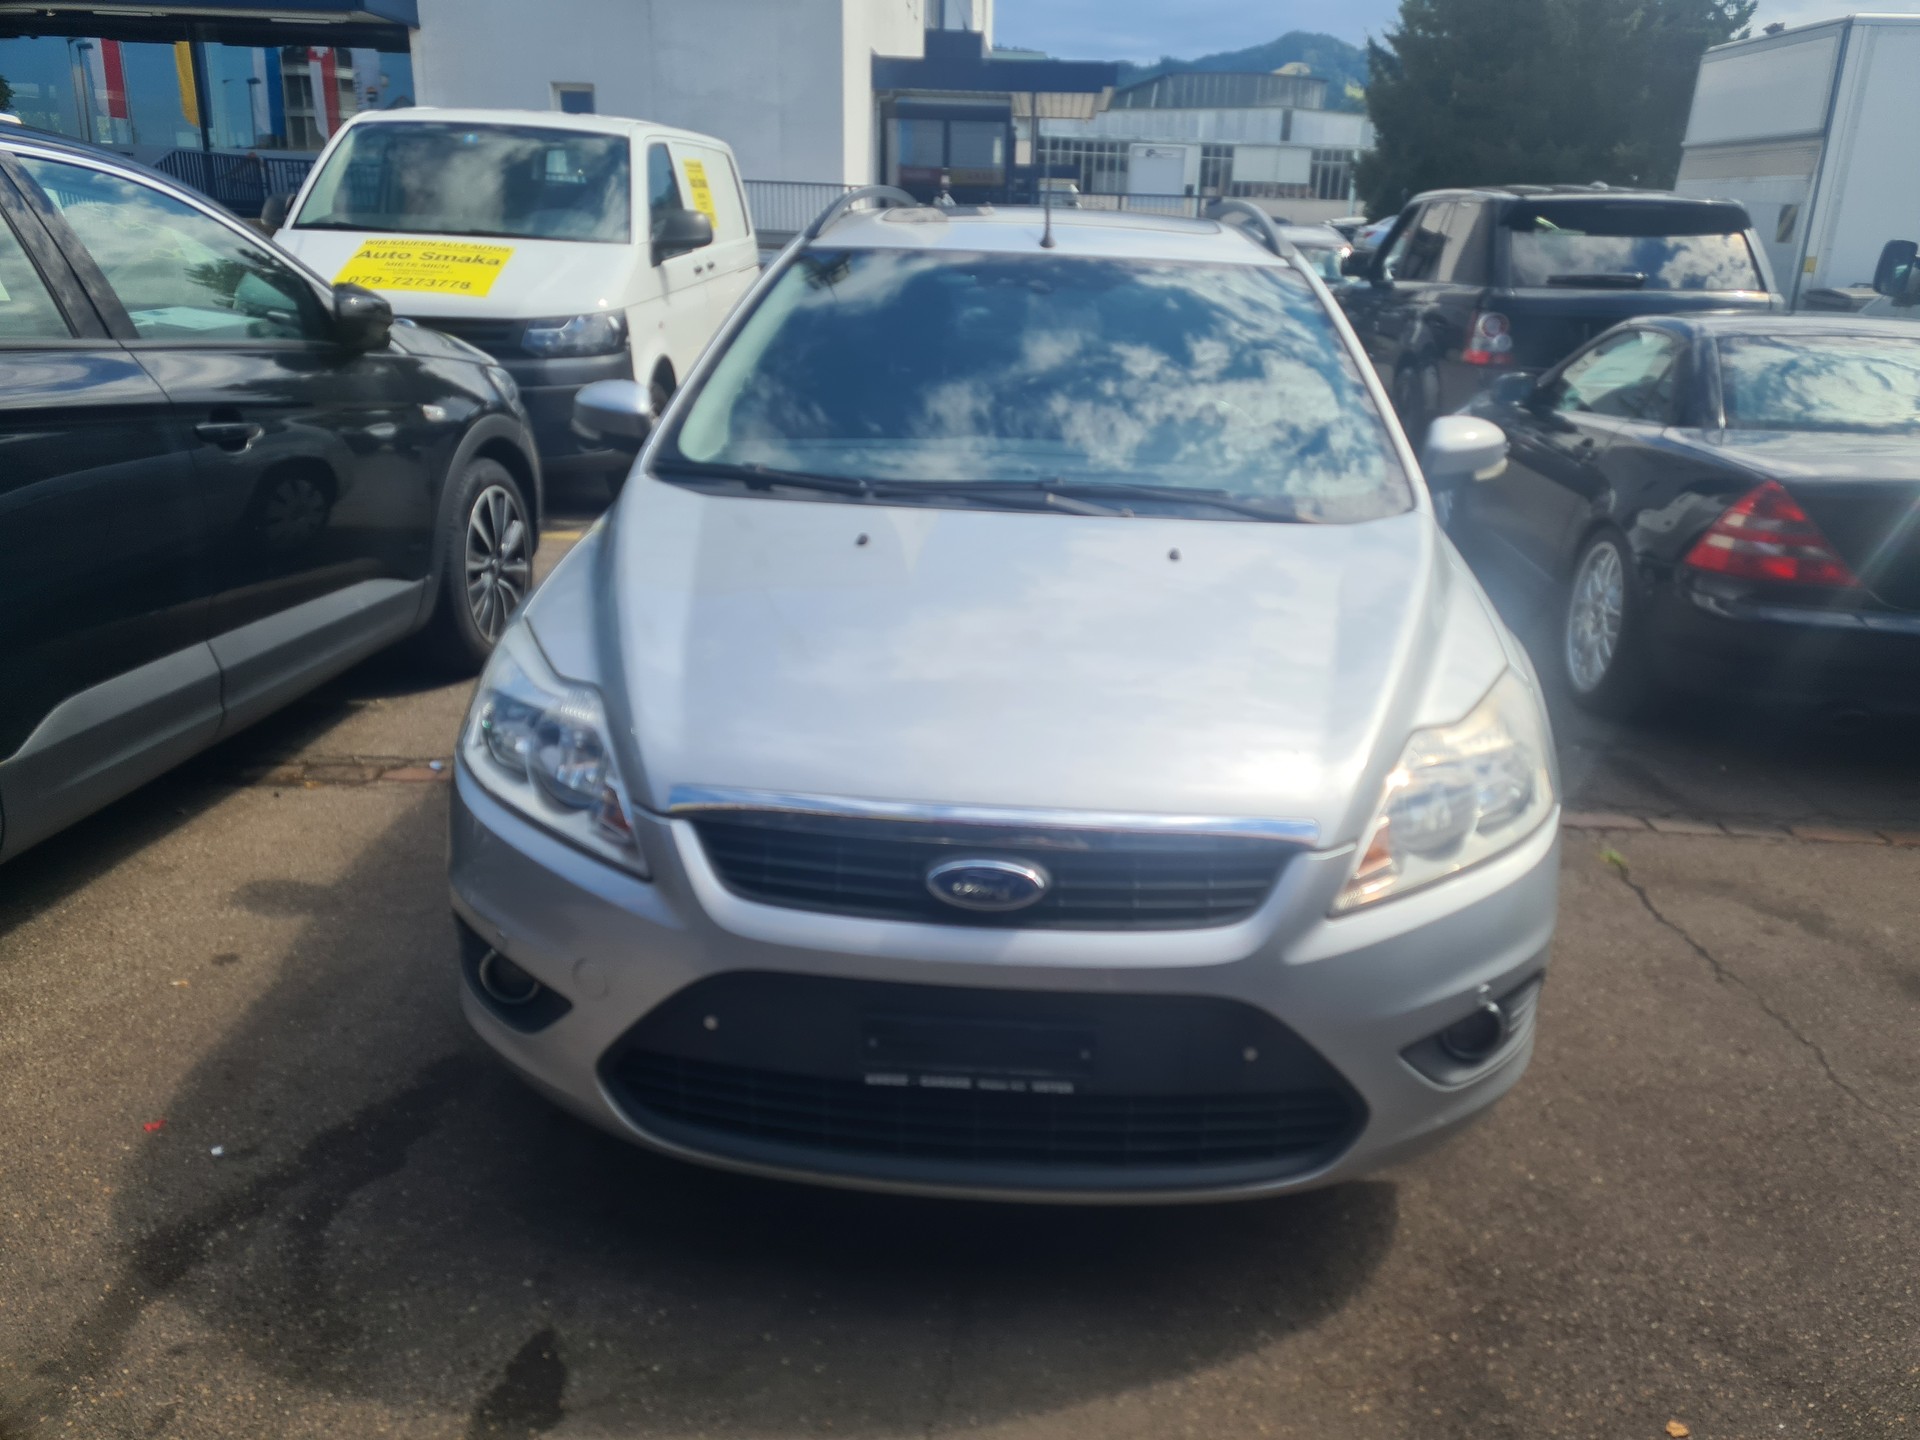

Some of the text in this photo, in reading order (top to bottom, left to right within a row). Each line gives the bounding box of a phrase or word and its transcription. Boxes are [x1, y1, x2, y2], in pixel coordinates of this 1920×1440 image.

[354, 250, 500, 266] Auto Smaka
[347, 276, 472, 290] 079-7273778
